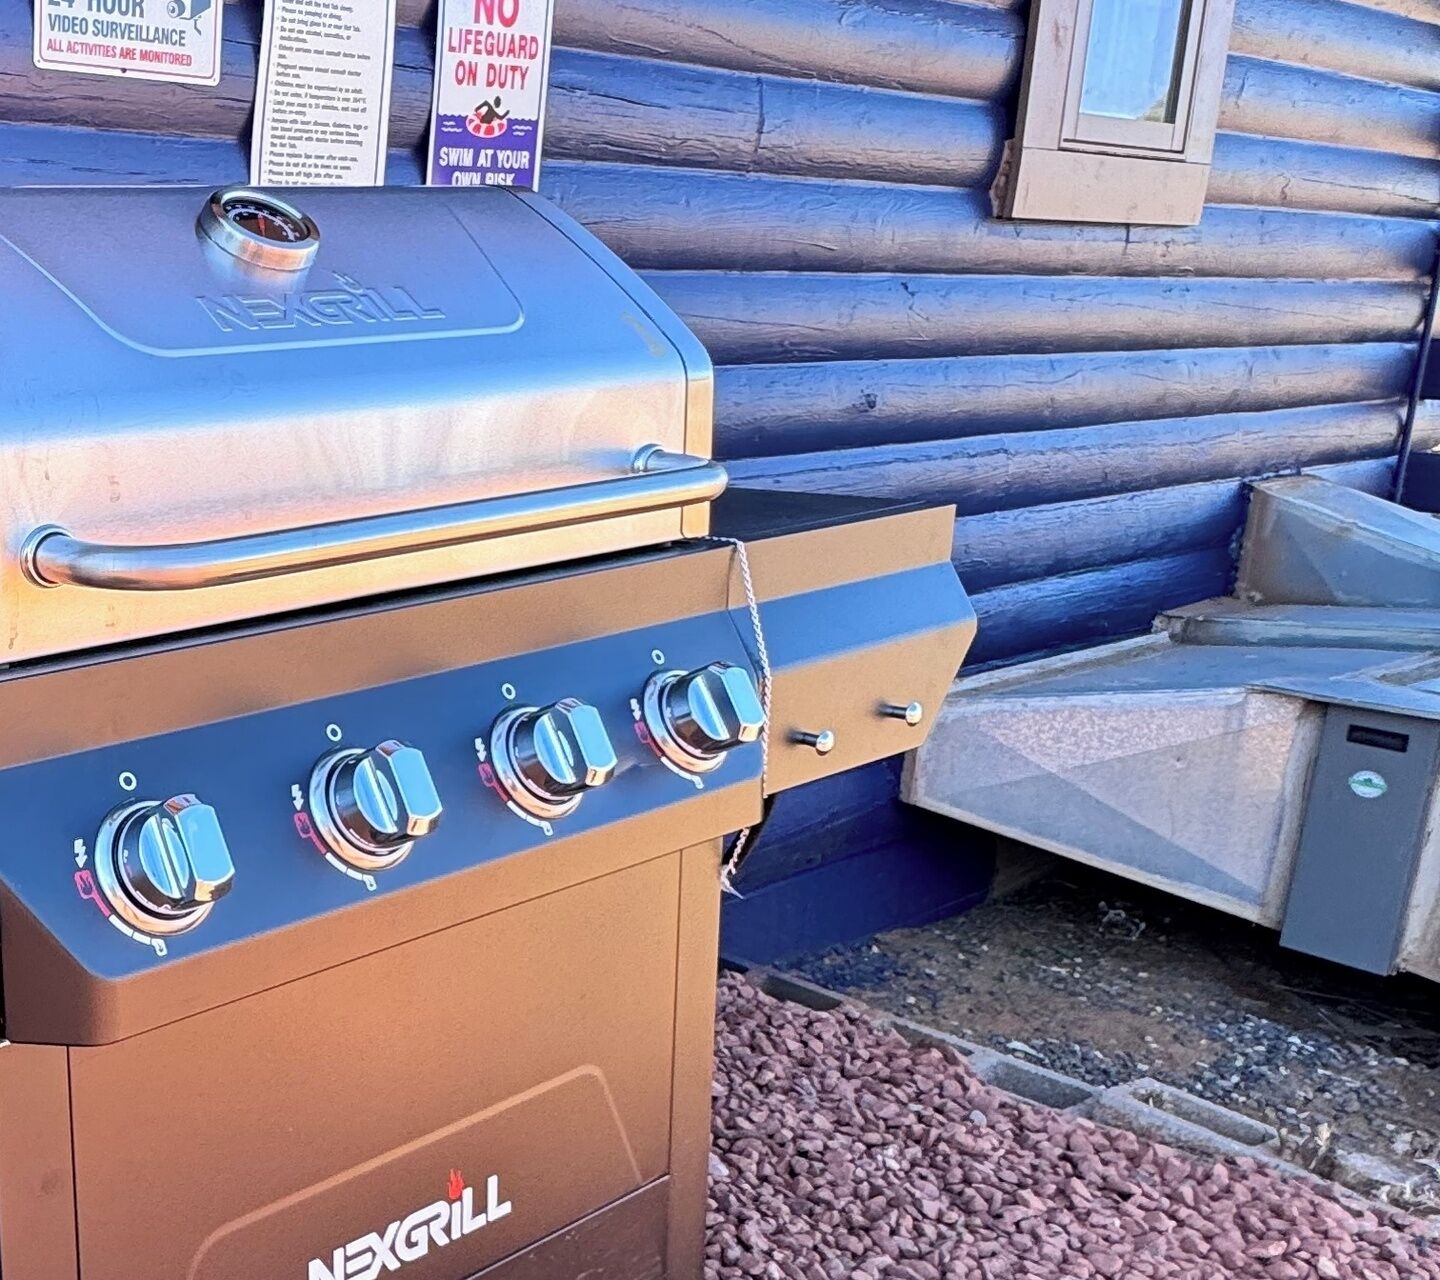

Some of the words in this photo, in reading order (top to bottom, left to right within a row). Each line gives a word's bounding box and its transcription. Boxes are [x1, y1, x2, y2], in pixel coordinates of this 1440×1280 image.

[48, 13, 88, 35] VIDEO
[92, 19, 186, 46] SURVEILLANCE
[448, 27, 539, 60] LIFEGUARD
[47, 38, 64, 52] ALL
[66, 41, 116, 58] ACTIVITIES
[119, 47, 136, 59] ARE
[140, 50, 192, 66] MONITORED
[455, 60, 478, 86] ON
[486, 63, 529, 90] DUTY
[439, 147, 473, 167] SWIM
[477, 149, 493, 168] AT
[497, 150, 529, 169] YOUR
[452, 172, 480, 186] OWN
